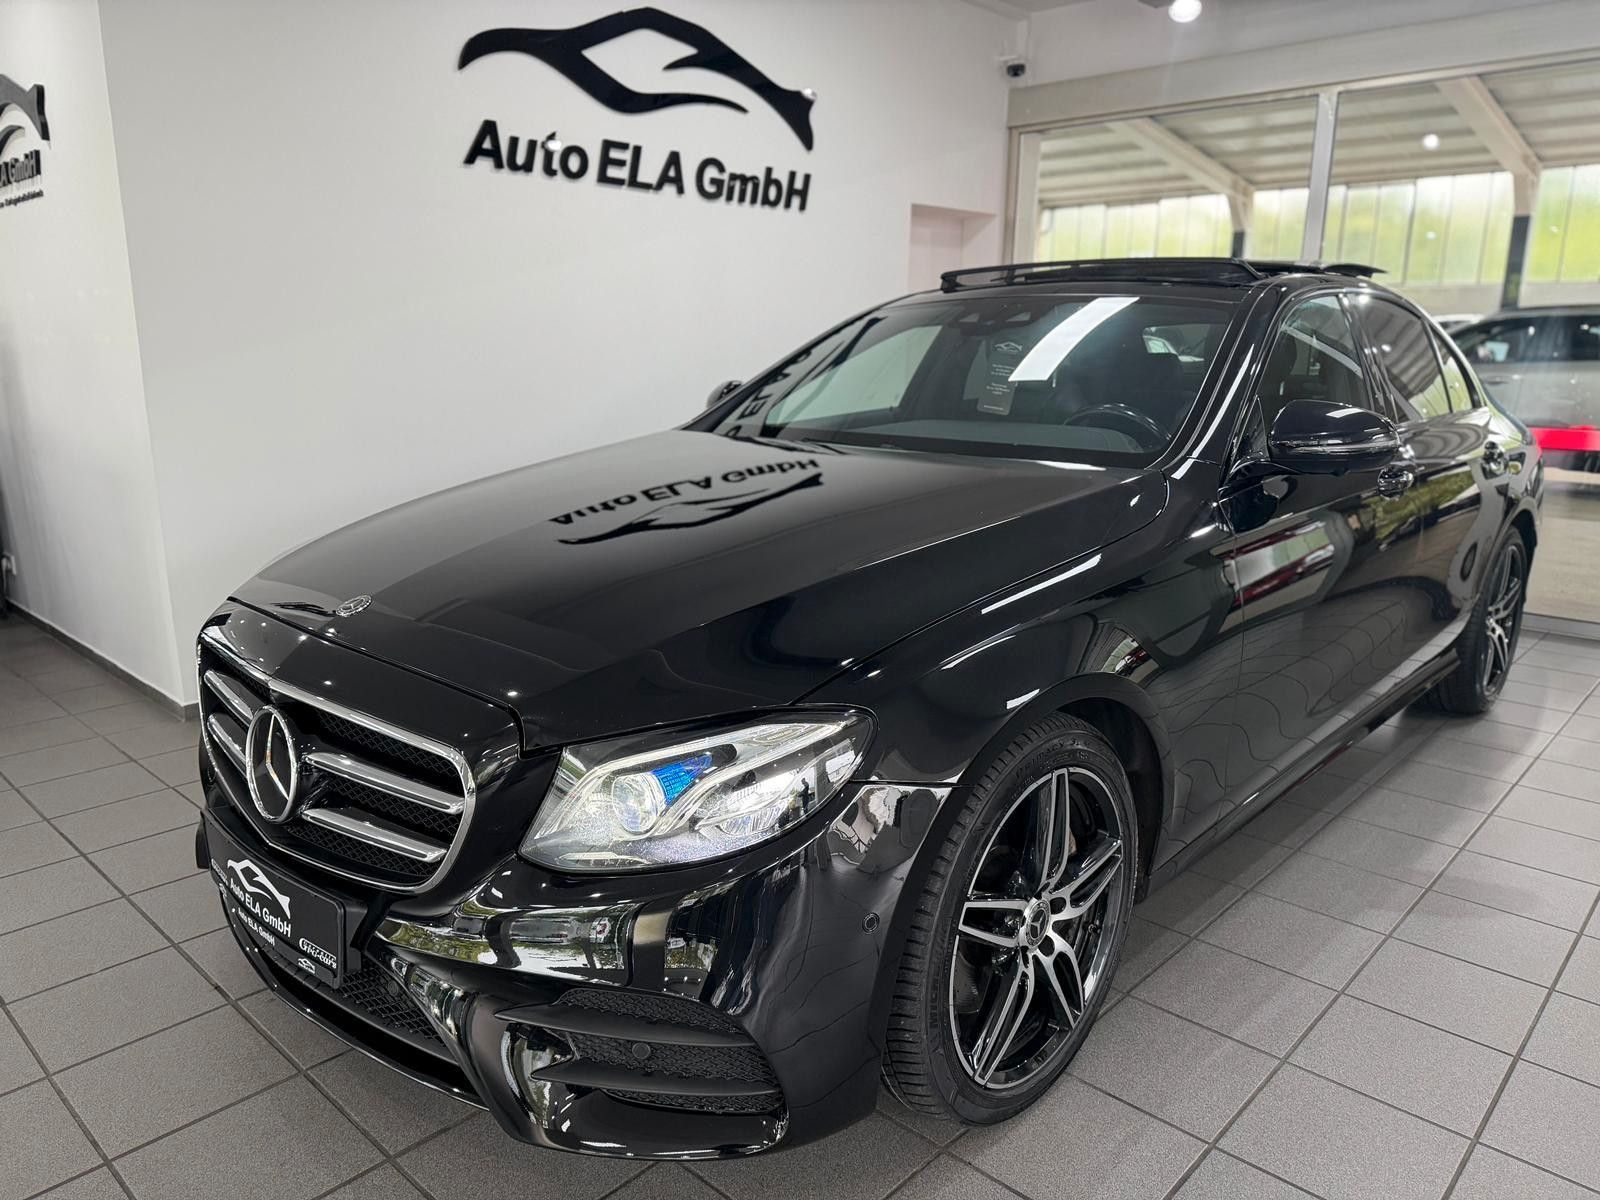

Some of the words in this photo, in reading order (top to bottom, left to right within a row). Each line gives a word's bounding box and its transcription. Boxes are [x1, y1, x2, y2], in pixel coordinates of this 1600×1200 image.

[463, 119, 589, 180] Auto
[596, 138, 685, 195] ELA
[694, 157, 812, 212] GmbH
[230, 877, 245, 902] Auto
[245, 894, 262, 918] ELA
[262, 907, 292, 938] GmbH
